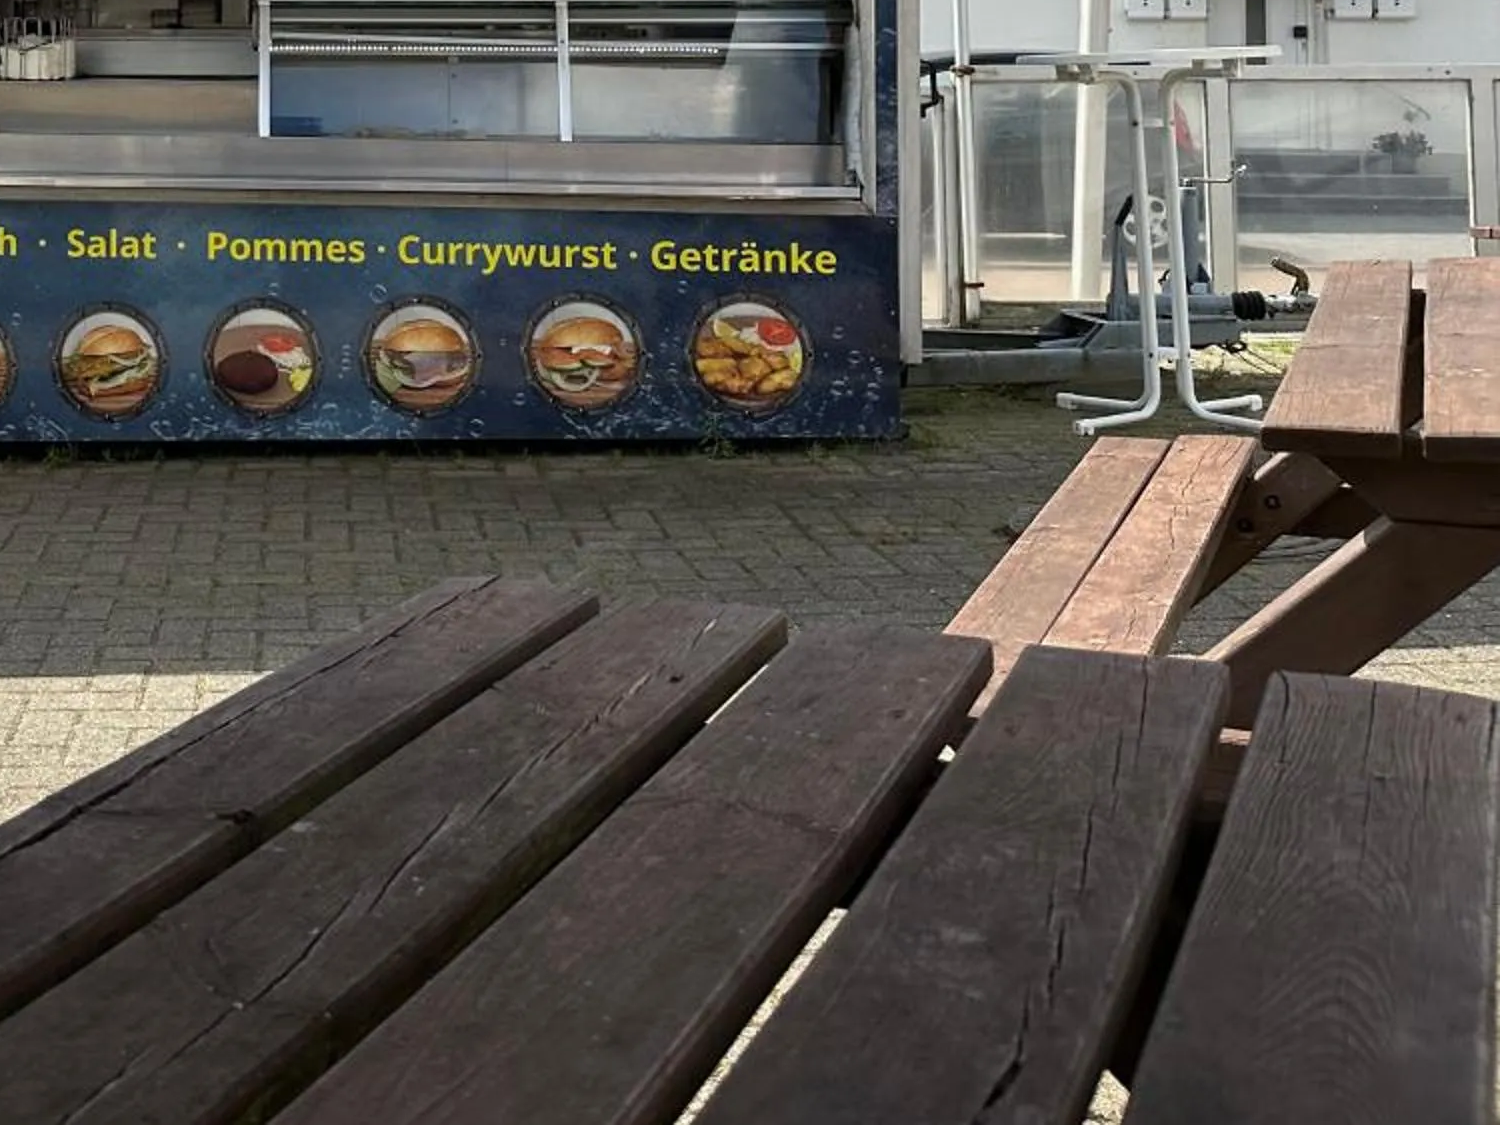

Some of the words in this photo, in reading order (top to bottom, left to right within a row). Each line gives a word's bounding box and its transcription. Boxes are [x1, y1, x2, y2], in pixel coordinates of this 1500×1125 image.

[66, 228, 157, 260] Salat
[206, 230, 365, 263] Pommes
[397, 233, 617, 274] Currywurst
[650, 239, 838, 275] Getränke
